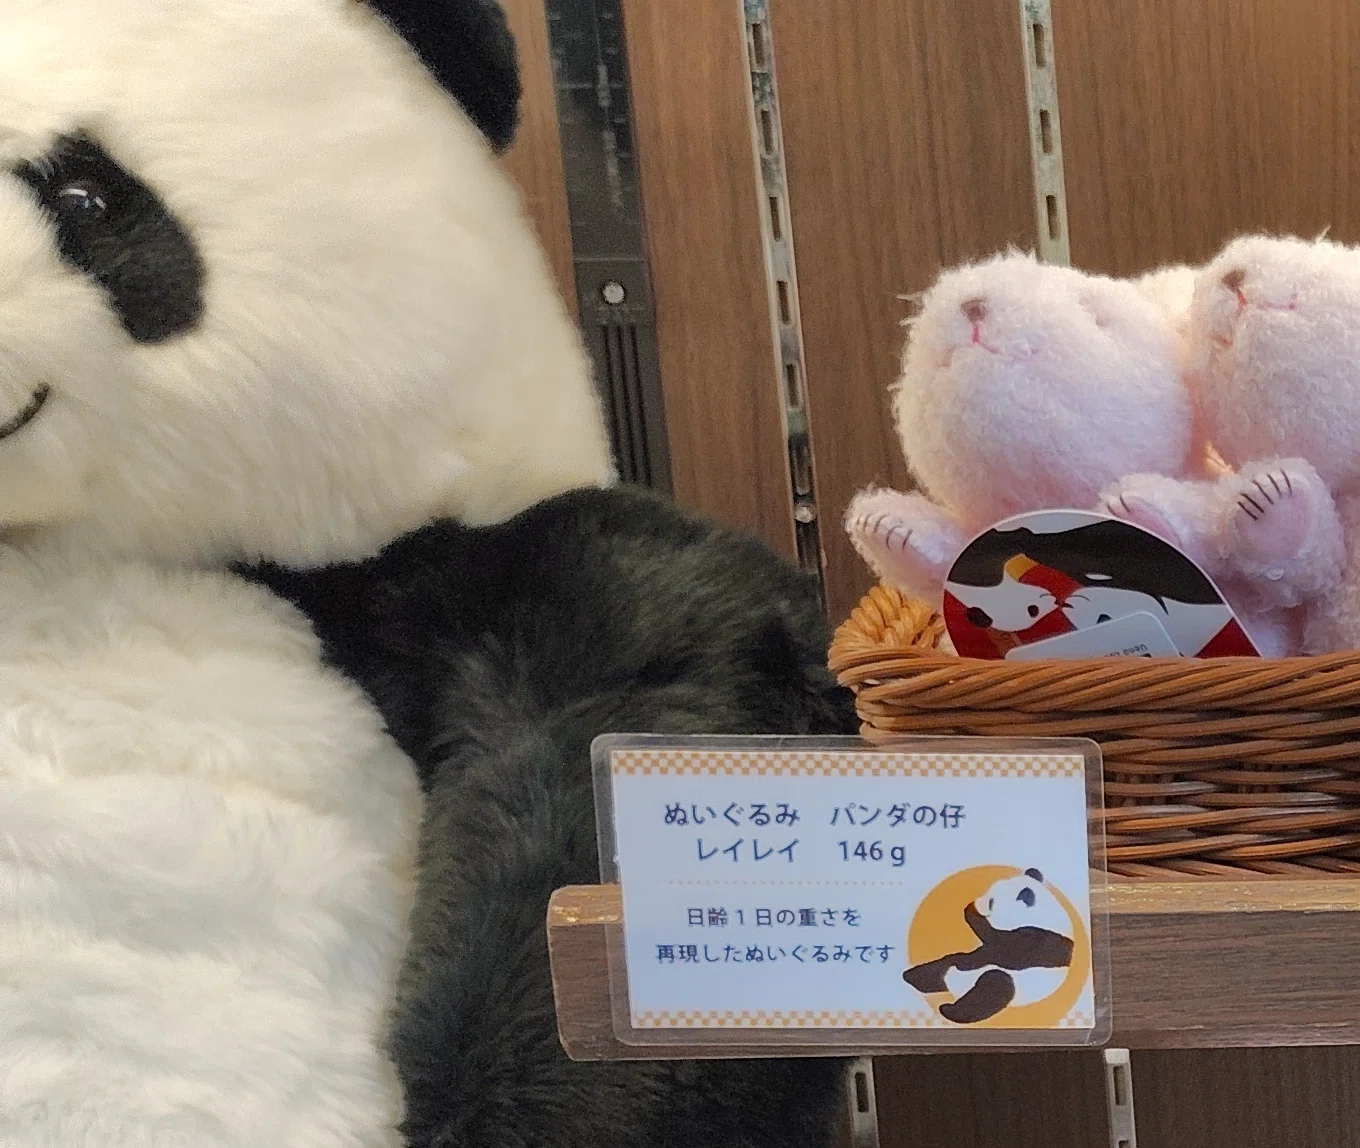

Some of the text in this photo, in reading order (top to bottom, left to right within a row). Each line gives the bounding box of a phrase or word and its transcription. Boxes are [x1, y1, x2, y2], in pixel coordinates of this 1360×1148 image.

[664, 802, 967, 829] ぬいぐるみ パンダの仔
[696, 839, 801, 863] レイレイ
[656, 944, 895, 964] 再現したぬいぐるみです
